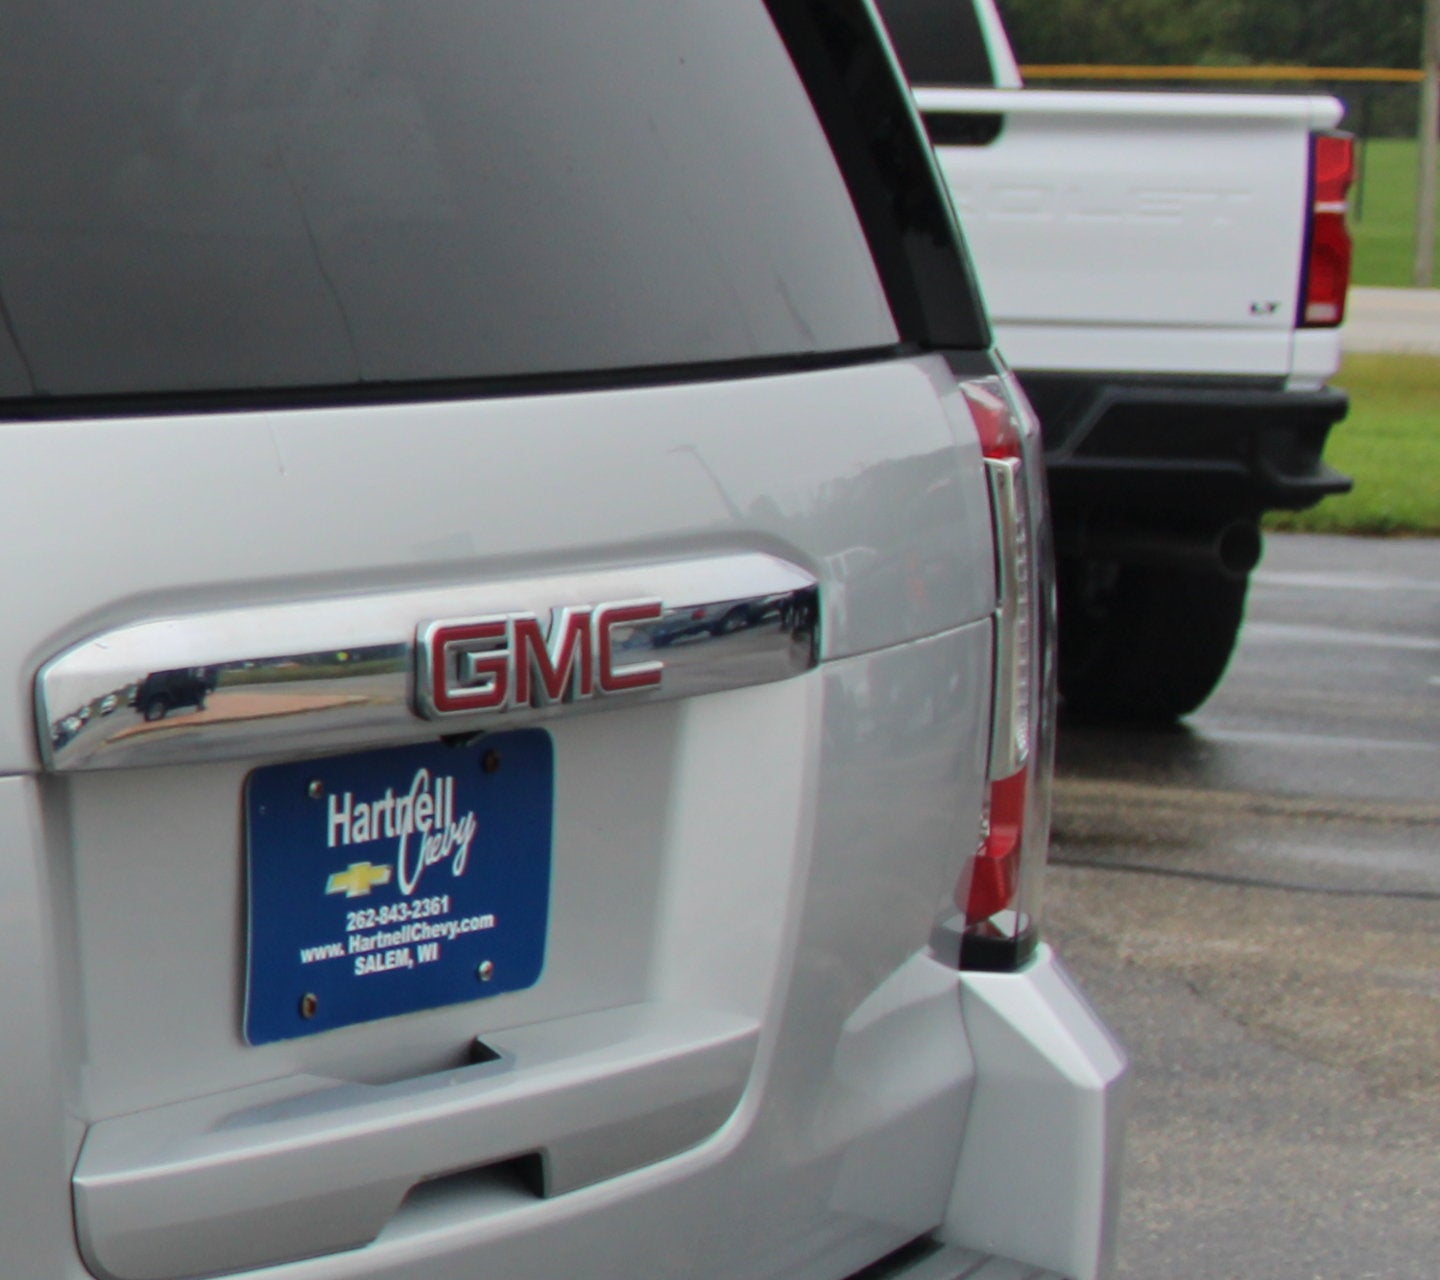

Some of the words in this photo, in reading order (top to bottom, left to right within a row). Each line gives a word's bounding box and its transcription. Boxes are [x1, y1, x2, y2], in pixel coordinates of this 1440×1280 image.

[414, 597, 665, 719] GMC
[327, 776, 456, 847] Hartnell
[397, 768, 476, 895] Chevy
[346, 895, 450, 932] 262-843-2361
[354, 946, 414, 976] SALEM,
[417, 942, 439, 963] WI
